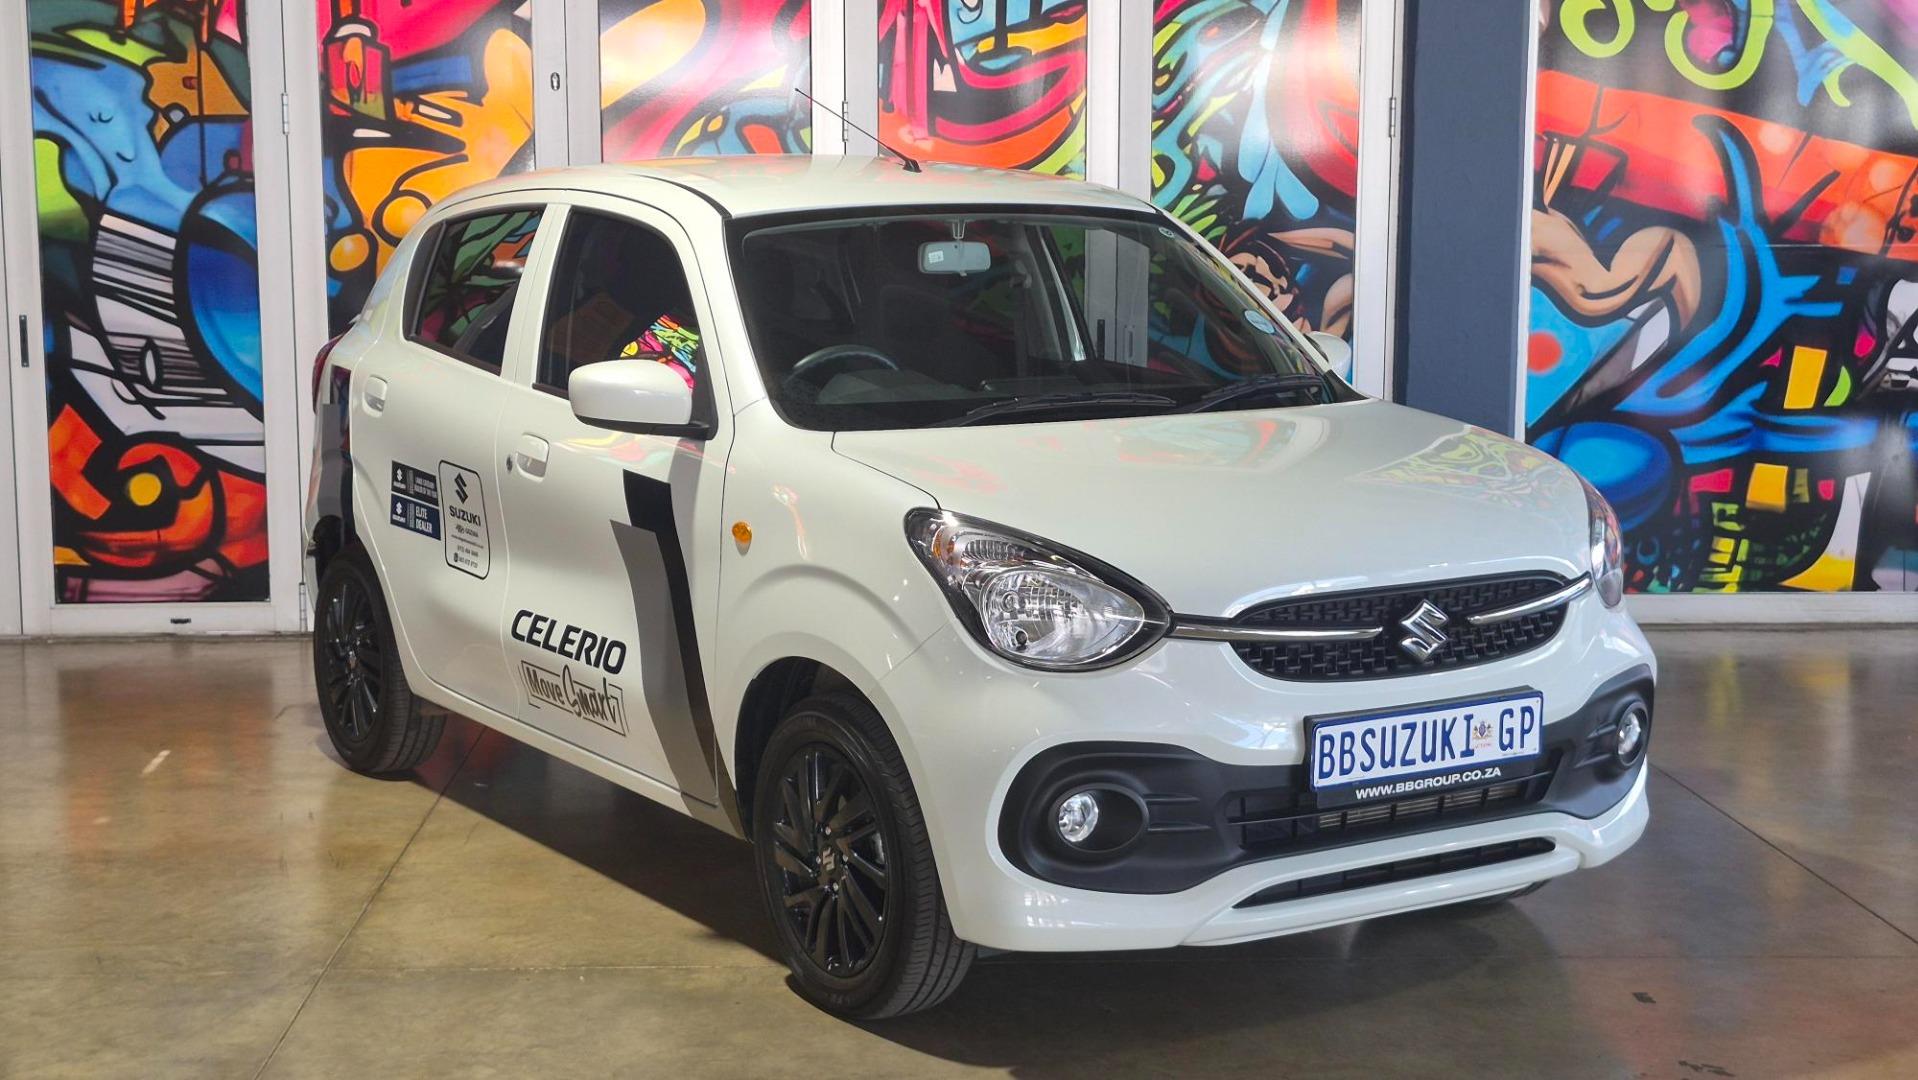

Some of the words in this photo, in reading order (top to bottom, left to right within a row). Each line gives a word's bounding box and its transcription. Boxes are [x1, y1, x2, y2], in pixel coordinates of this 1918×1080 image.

[416, 519, 432, 534] DEALER
[449, 505, 481, 526] SUZUKI
[511, 609, 627, 675] CELERIO
[526, 666, 565, 705] Move
[562, 664, 619, 723] Smart
[1318, 713, 1476, 780] BBSUZUKI
[1498, 705, 1535, 752] GP
[1355, 766, 1502, 800] WWW.BBGROUP.CO.ZA
